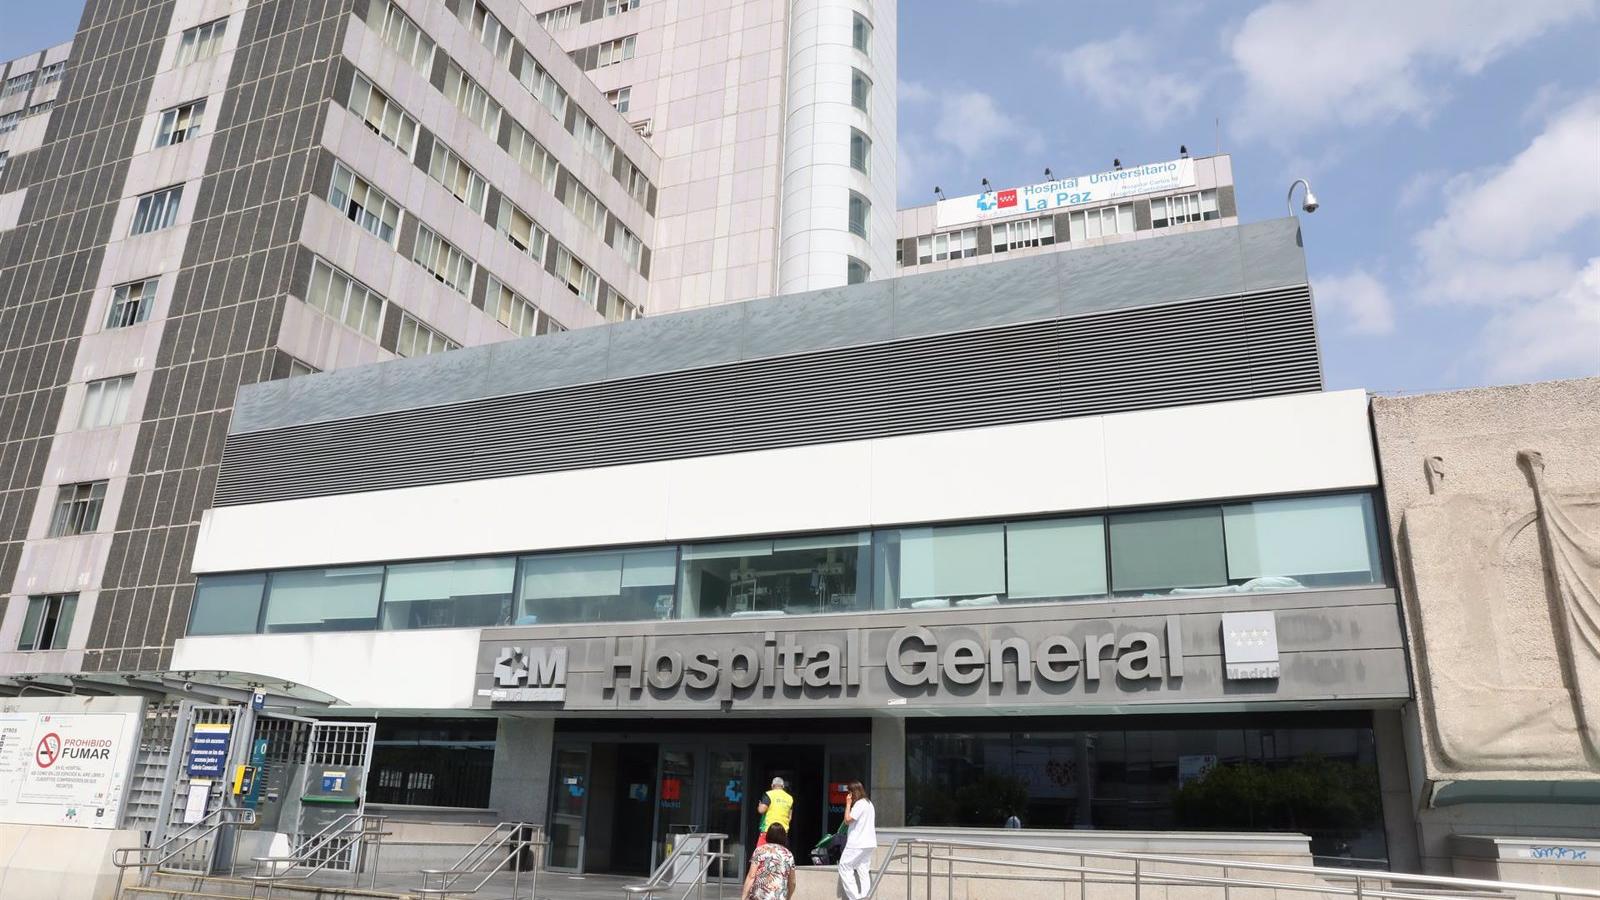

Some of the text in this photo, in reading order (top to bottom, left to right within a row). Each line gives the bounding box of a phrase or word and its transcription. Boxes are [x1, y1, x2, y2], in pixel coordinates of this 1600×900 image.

[1024, 163, 1177, 196] Hospital Universitario
[1025, 191, 1092, 212] La Paz
[601, 615, 1184, 701] Hospital General
[1228, 666, 1280, 679] Madrid
[64, 739, 112, 748] PROHIBIDO
[61, 747, 110, 760] FUMAR
